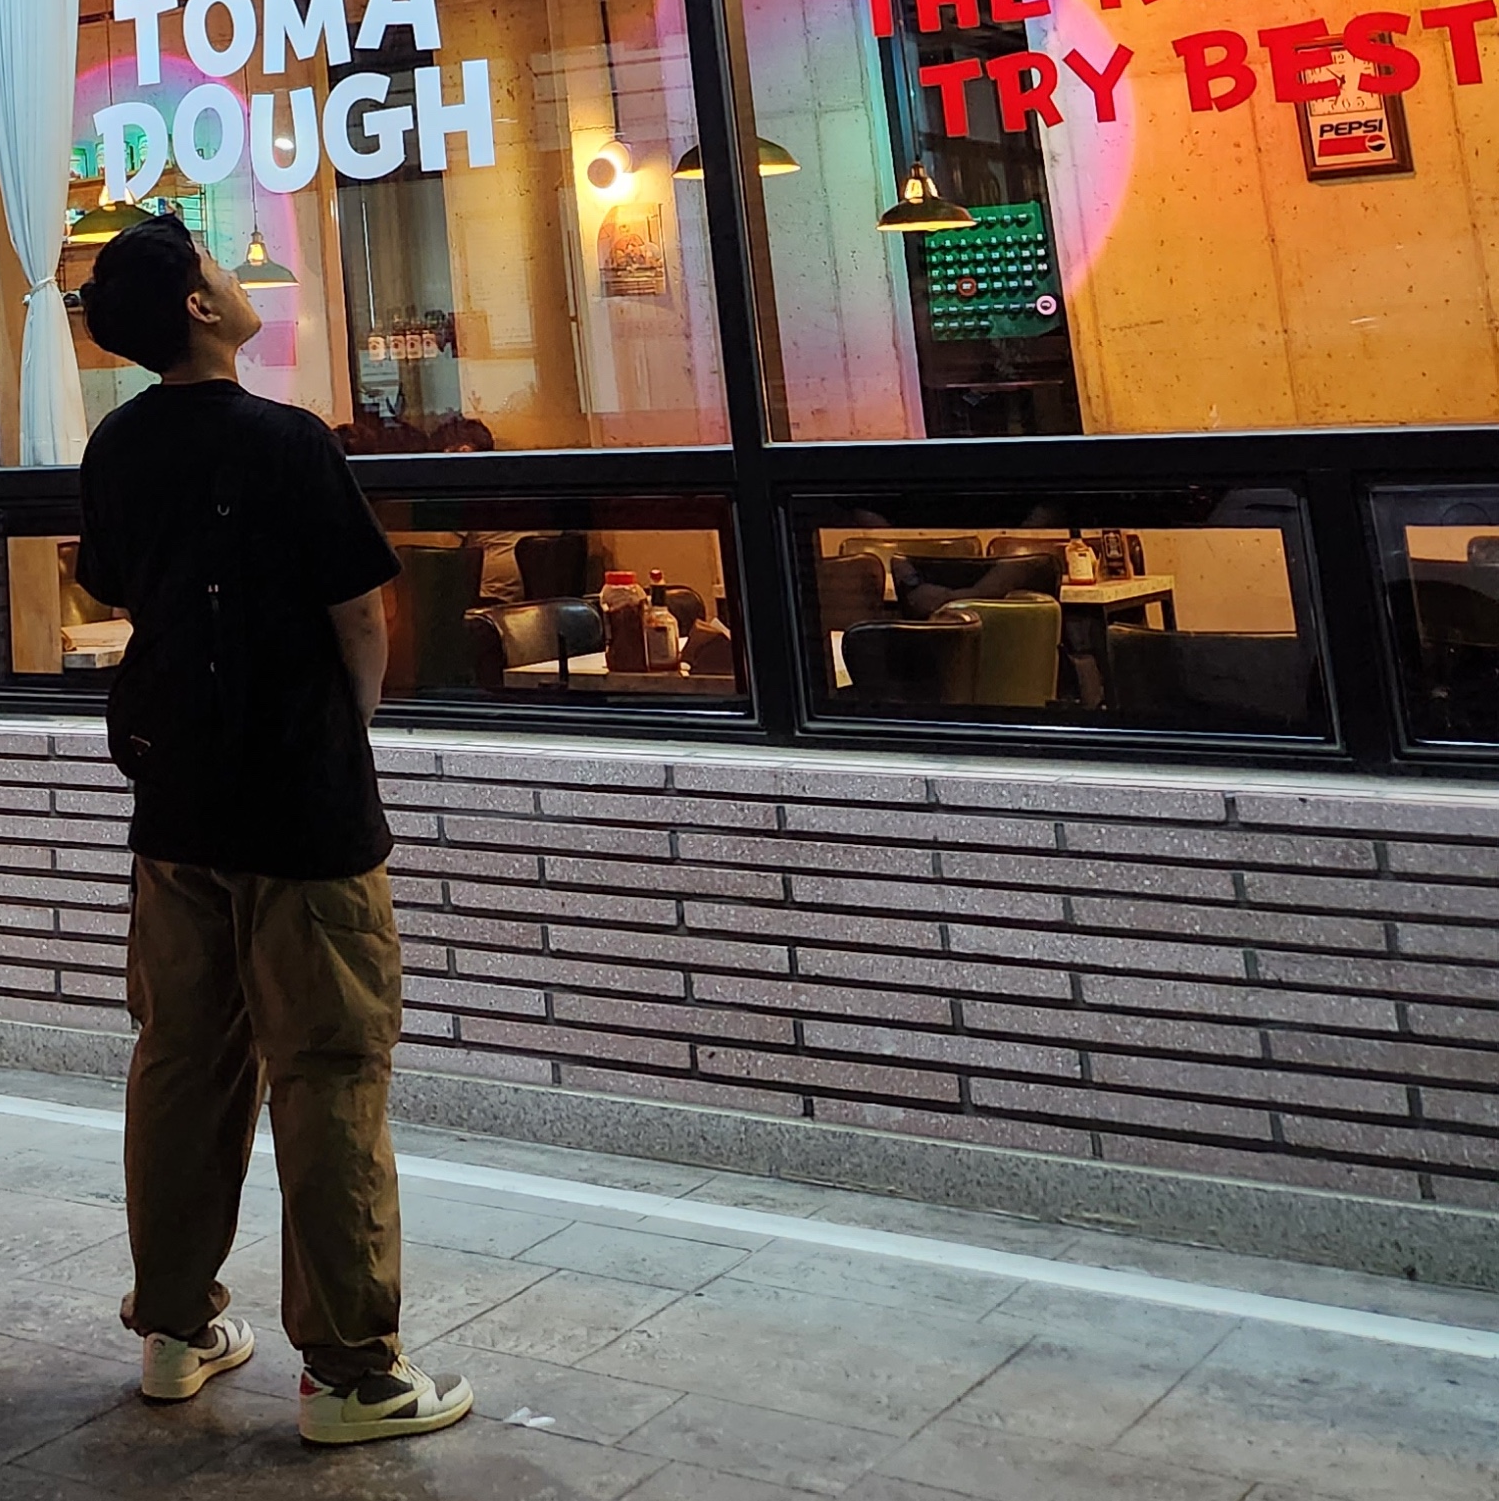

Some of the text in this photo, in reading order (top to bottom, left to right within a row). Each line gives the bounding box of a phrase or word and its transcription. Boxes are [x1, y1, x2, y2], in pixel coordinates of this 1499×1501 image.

[93, 58, 496, 202] DOUGH
[919, 43, 1135, 138] TRY
[1319, 118, 1384, 138] PEPSI
